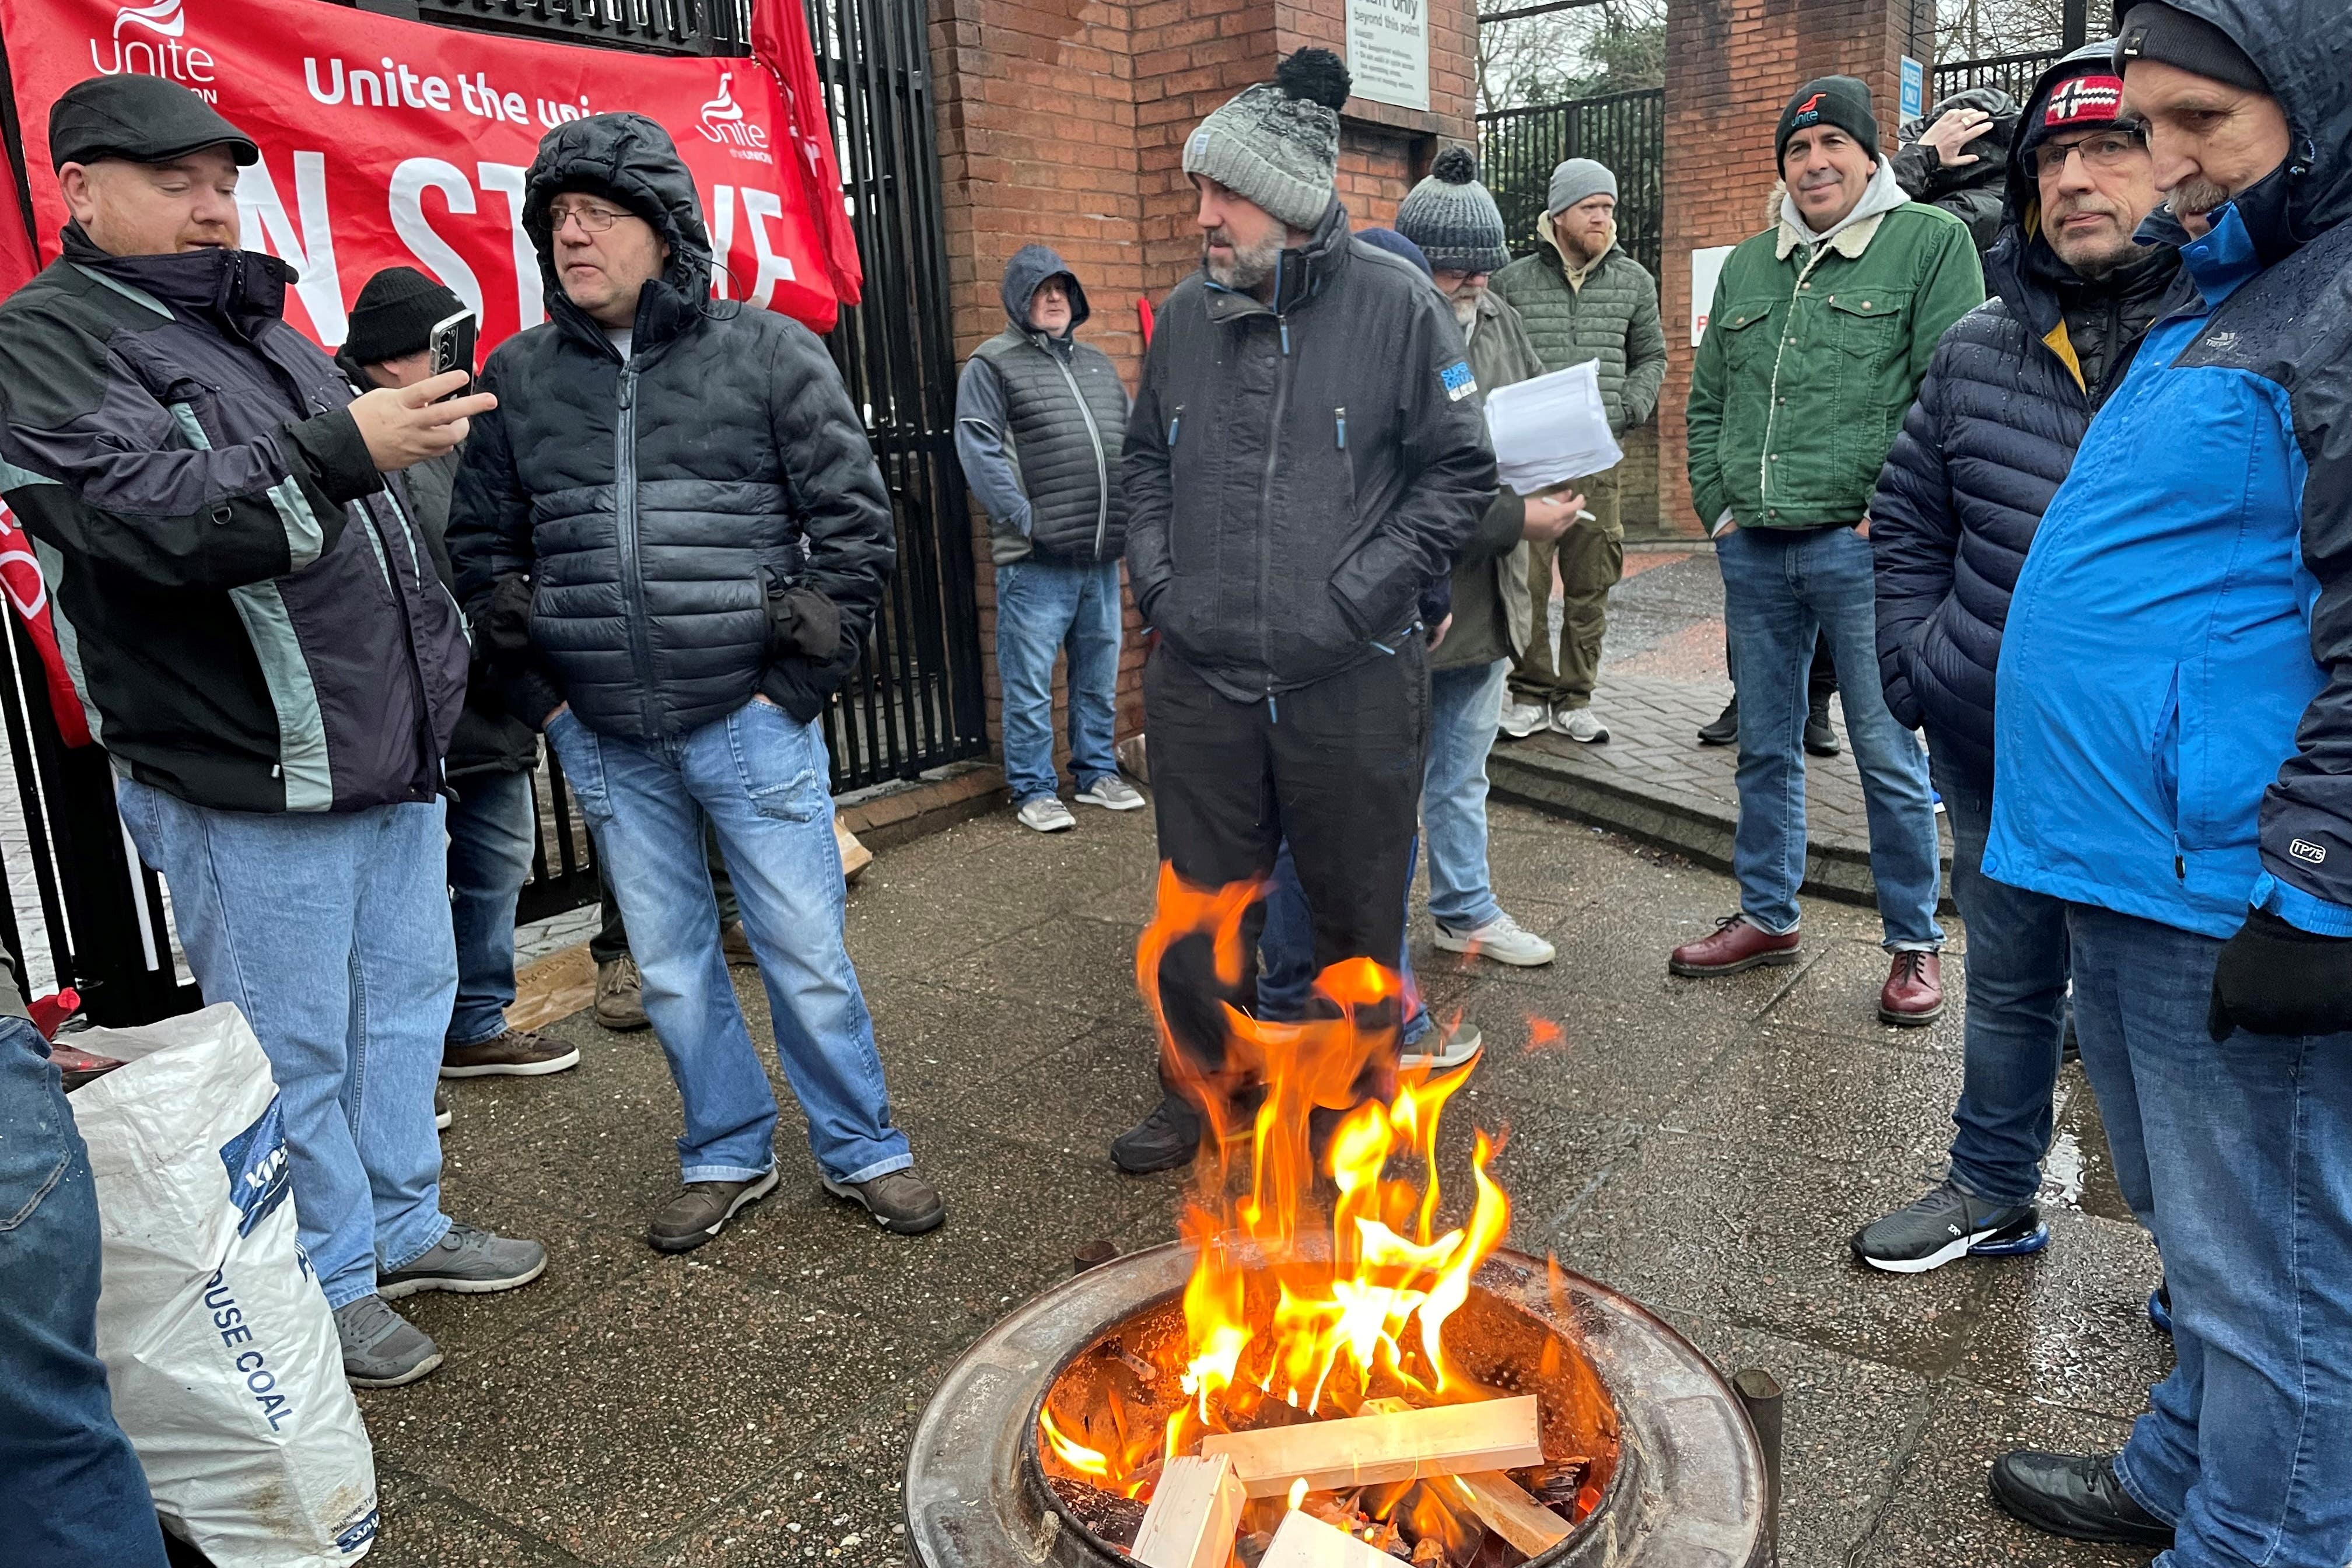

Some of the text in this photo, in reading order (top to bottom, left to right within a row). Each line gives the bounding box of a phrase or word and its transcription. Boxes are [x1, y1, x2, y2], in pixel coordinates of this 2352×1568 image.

[1354, 7, 1382, 26] beyond
[304, 57, 450, 112] Unite
[458, 72, 530, 125] the
[236, 150, 351, 347] N
[2294, 841, 2323, 859] TP75
[236, 1351, 293, 1432] COAL
